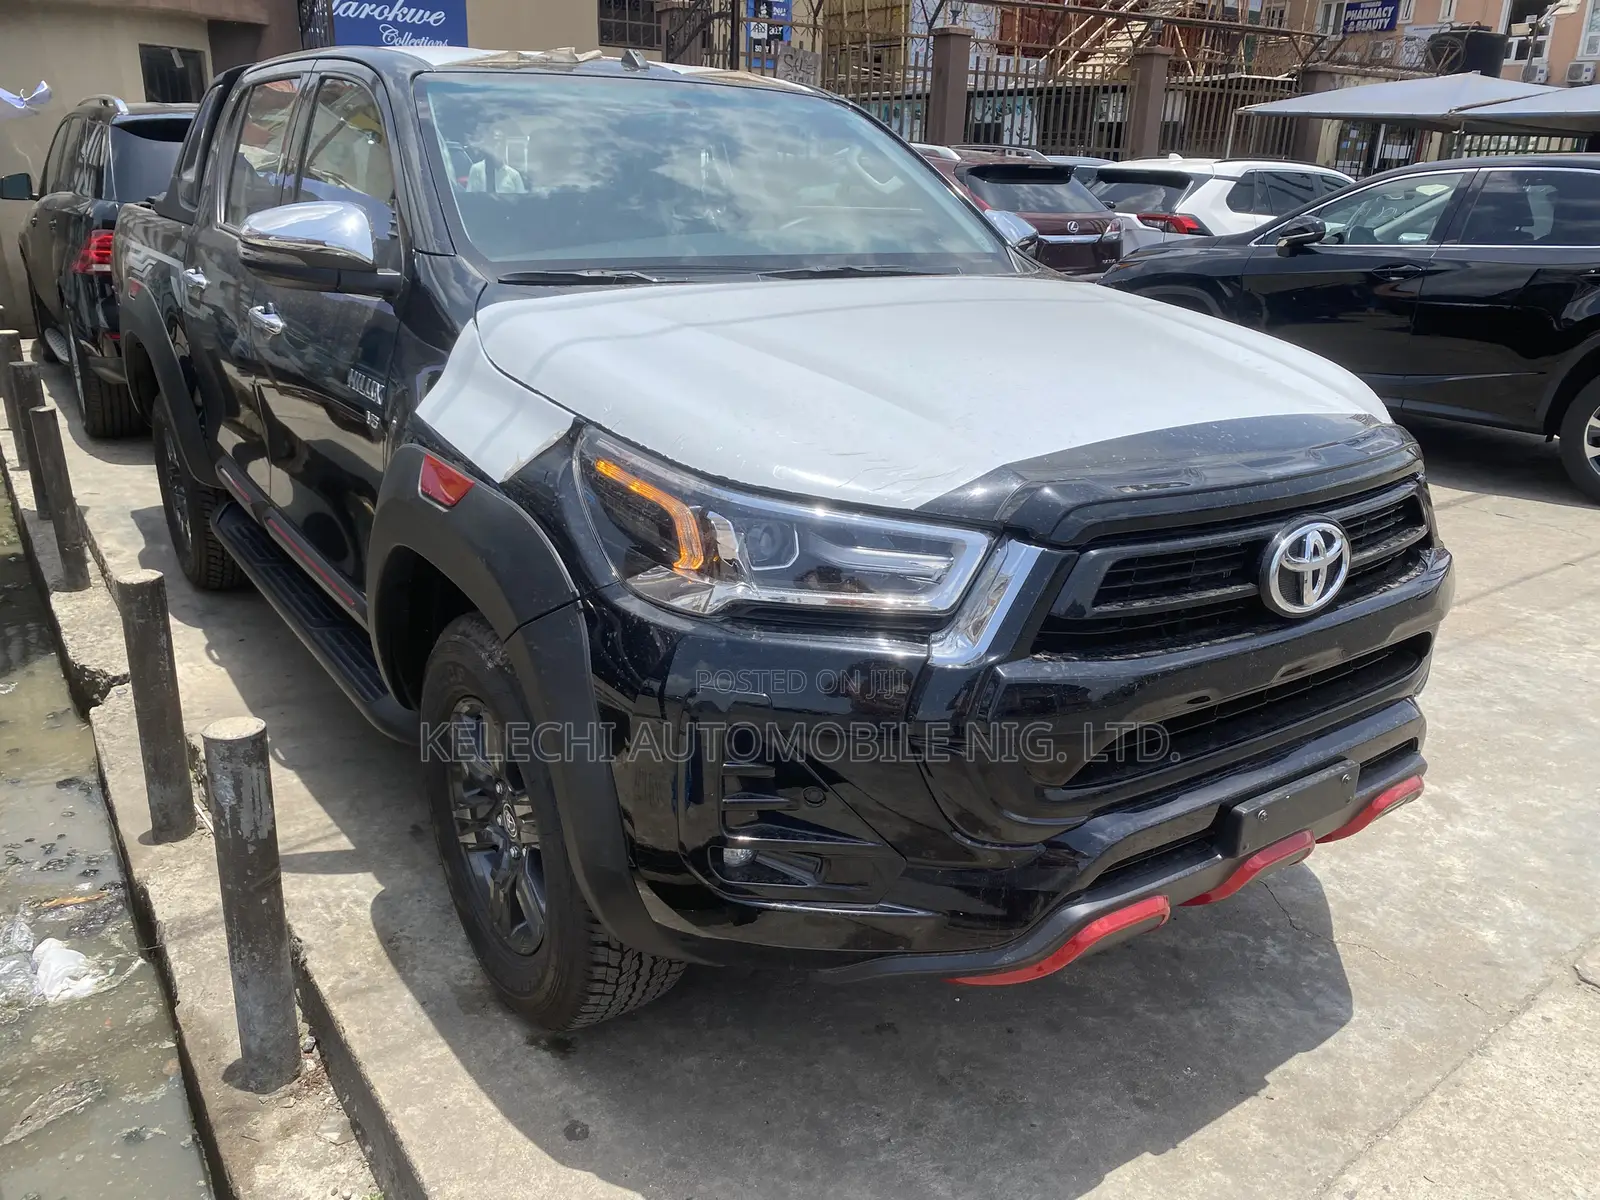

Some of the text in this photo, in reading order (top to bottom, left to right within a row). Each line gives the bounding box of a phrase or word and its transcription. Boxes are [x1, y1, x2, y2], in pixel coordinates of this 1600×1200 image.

[1345, 6, 1394, 21] PHARMACY
[1355, 18, 1391, 32] BEAUTY
[379, 24, 448, 47] Collections
[347, 368, 385, 405] HILUX
